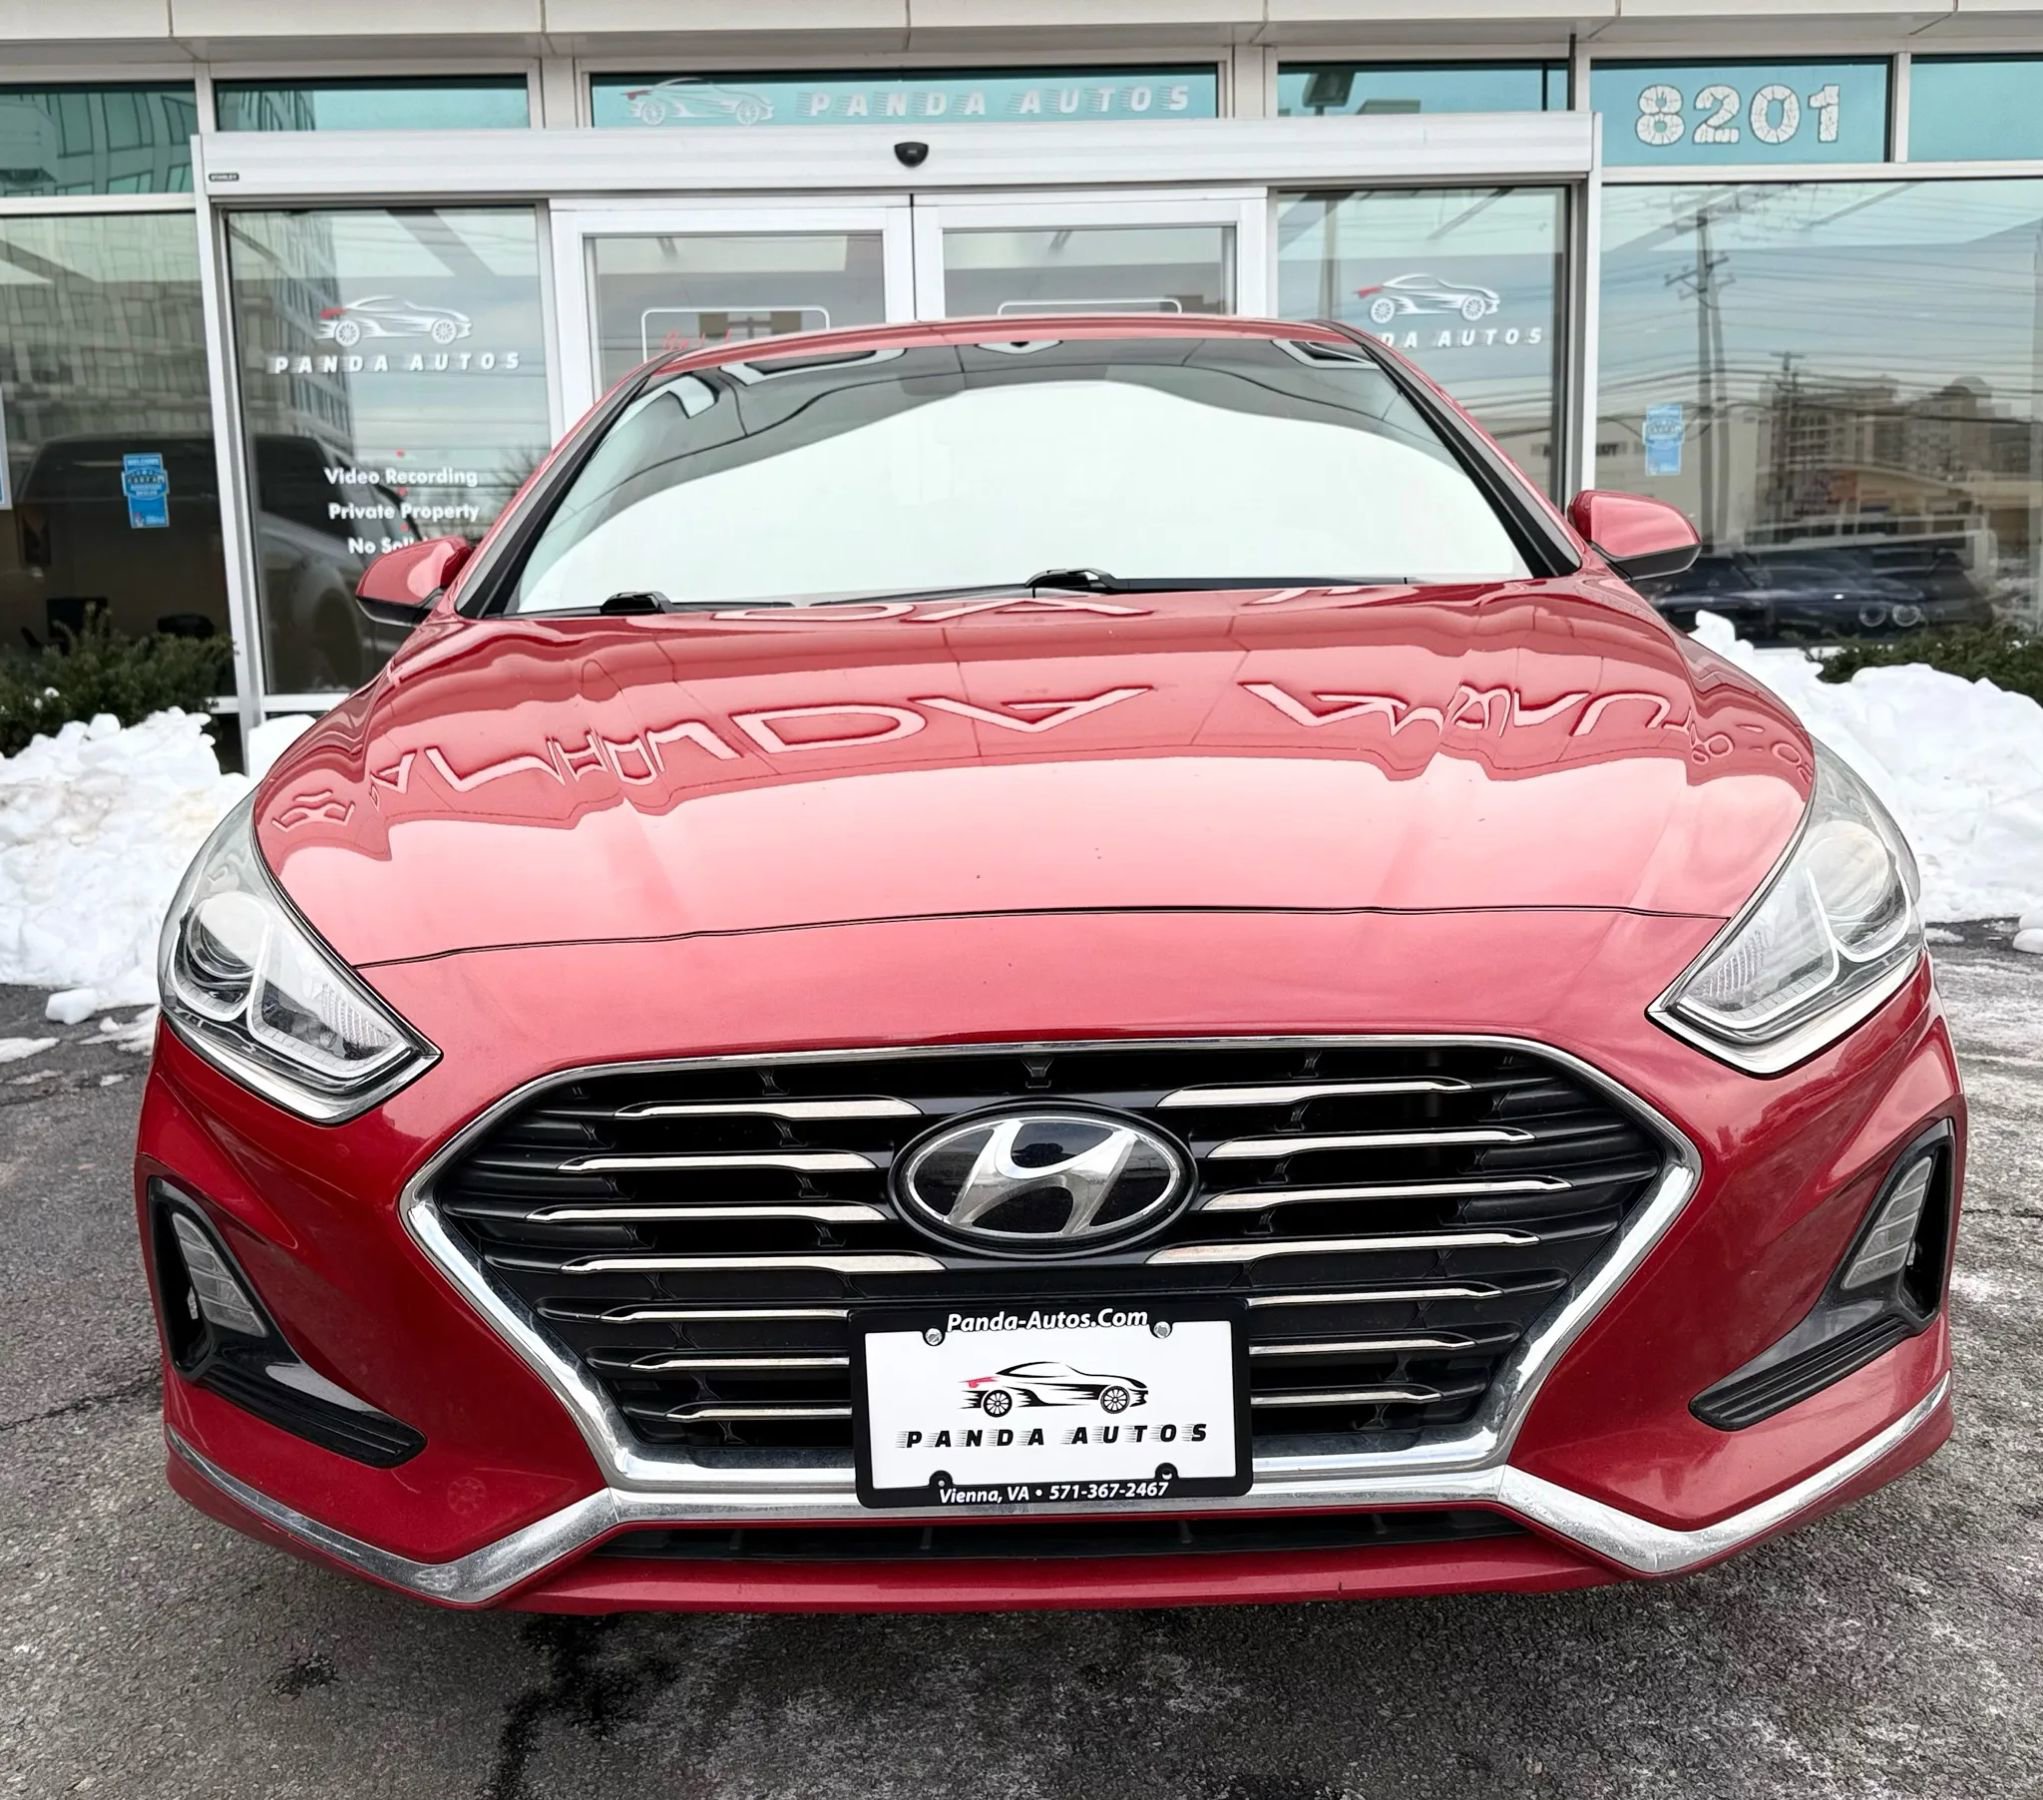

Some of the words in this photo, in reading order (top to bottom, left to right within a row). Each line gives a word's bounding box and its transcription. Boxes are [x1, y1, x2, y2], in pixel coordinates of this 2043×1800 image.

[809, 91, 986, 116] PANDA
[1018, 85, 1189, 114] AUTOS
[1635, 84, 1841, 145] 8201
[1437, 327, 1542, 347] AUTOS
[274, 354, 389, 374] PANDA
[409, 352, 519, 371] AUTOS
[324, 466, 380, 485] Video
[385, 467, 478, 487] Recording
[328, 502, 395, 520] Private
[401, 502, 479, 522] Property
[347, 537, 377, 554] No
[946, 1308, 1149, 1333] Panda-Autos.Com
[906, 1428, 1044, 1449] PANDA
[1071, 1423, 1207, 1445] AUTOS
[938, 1487, 1003, 1504] Vienna,
[1006, 1486, 1031, 1501] VA
[1049, 1482, 1168, 1500] 571-367-2467
